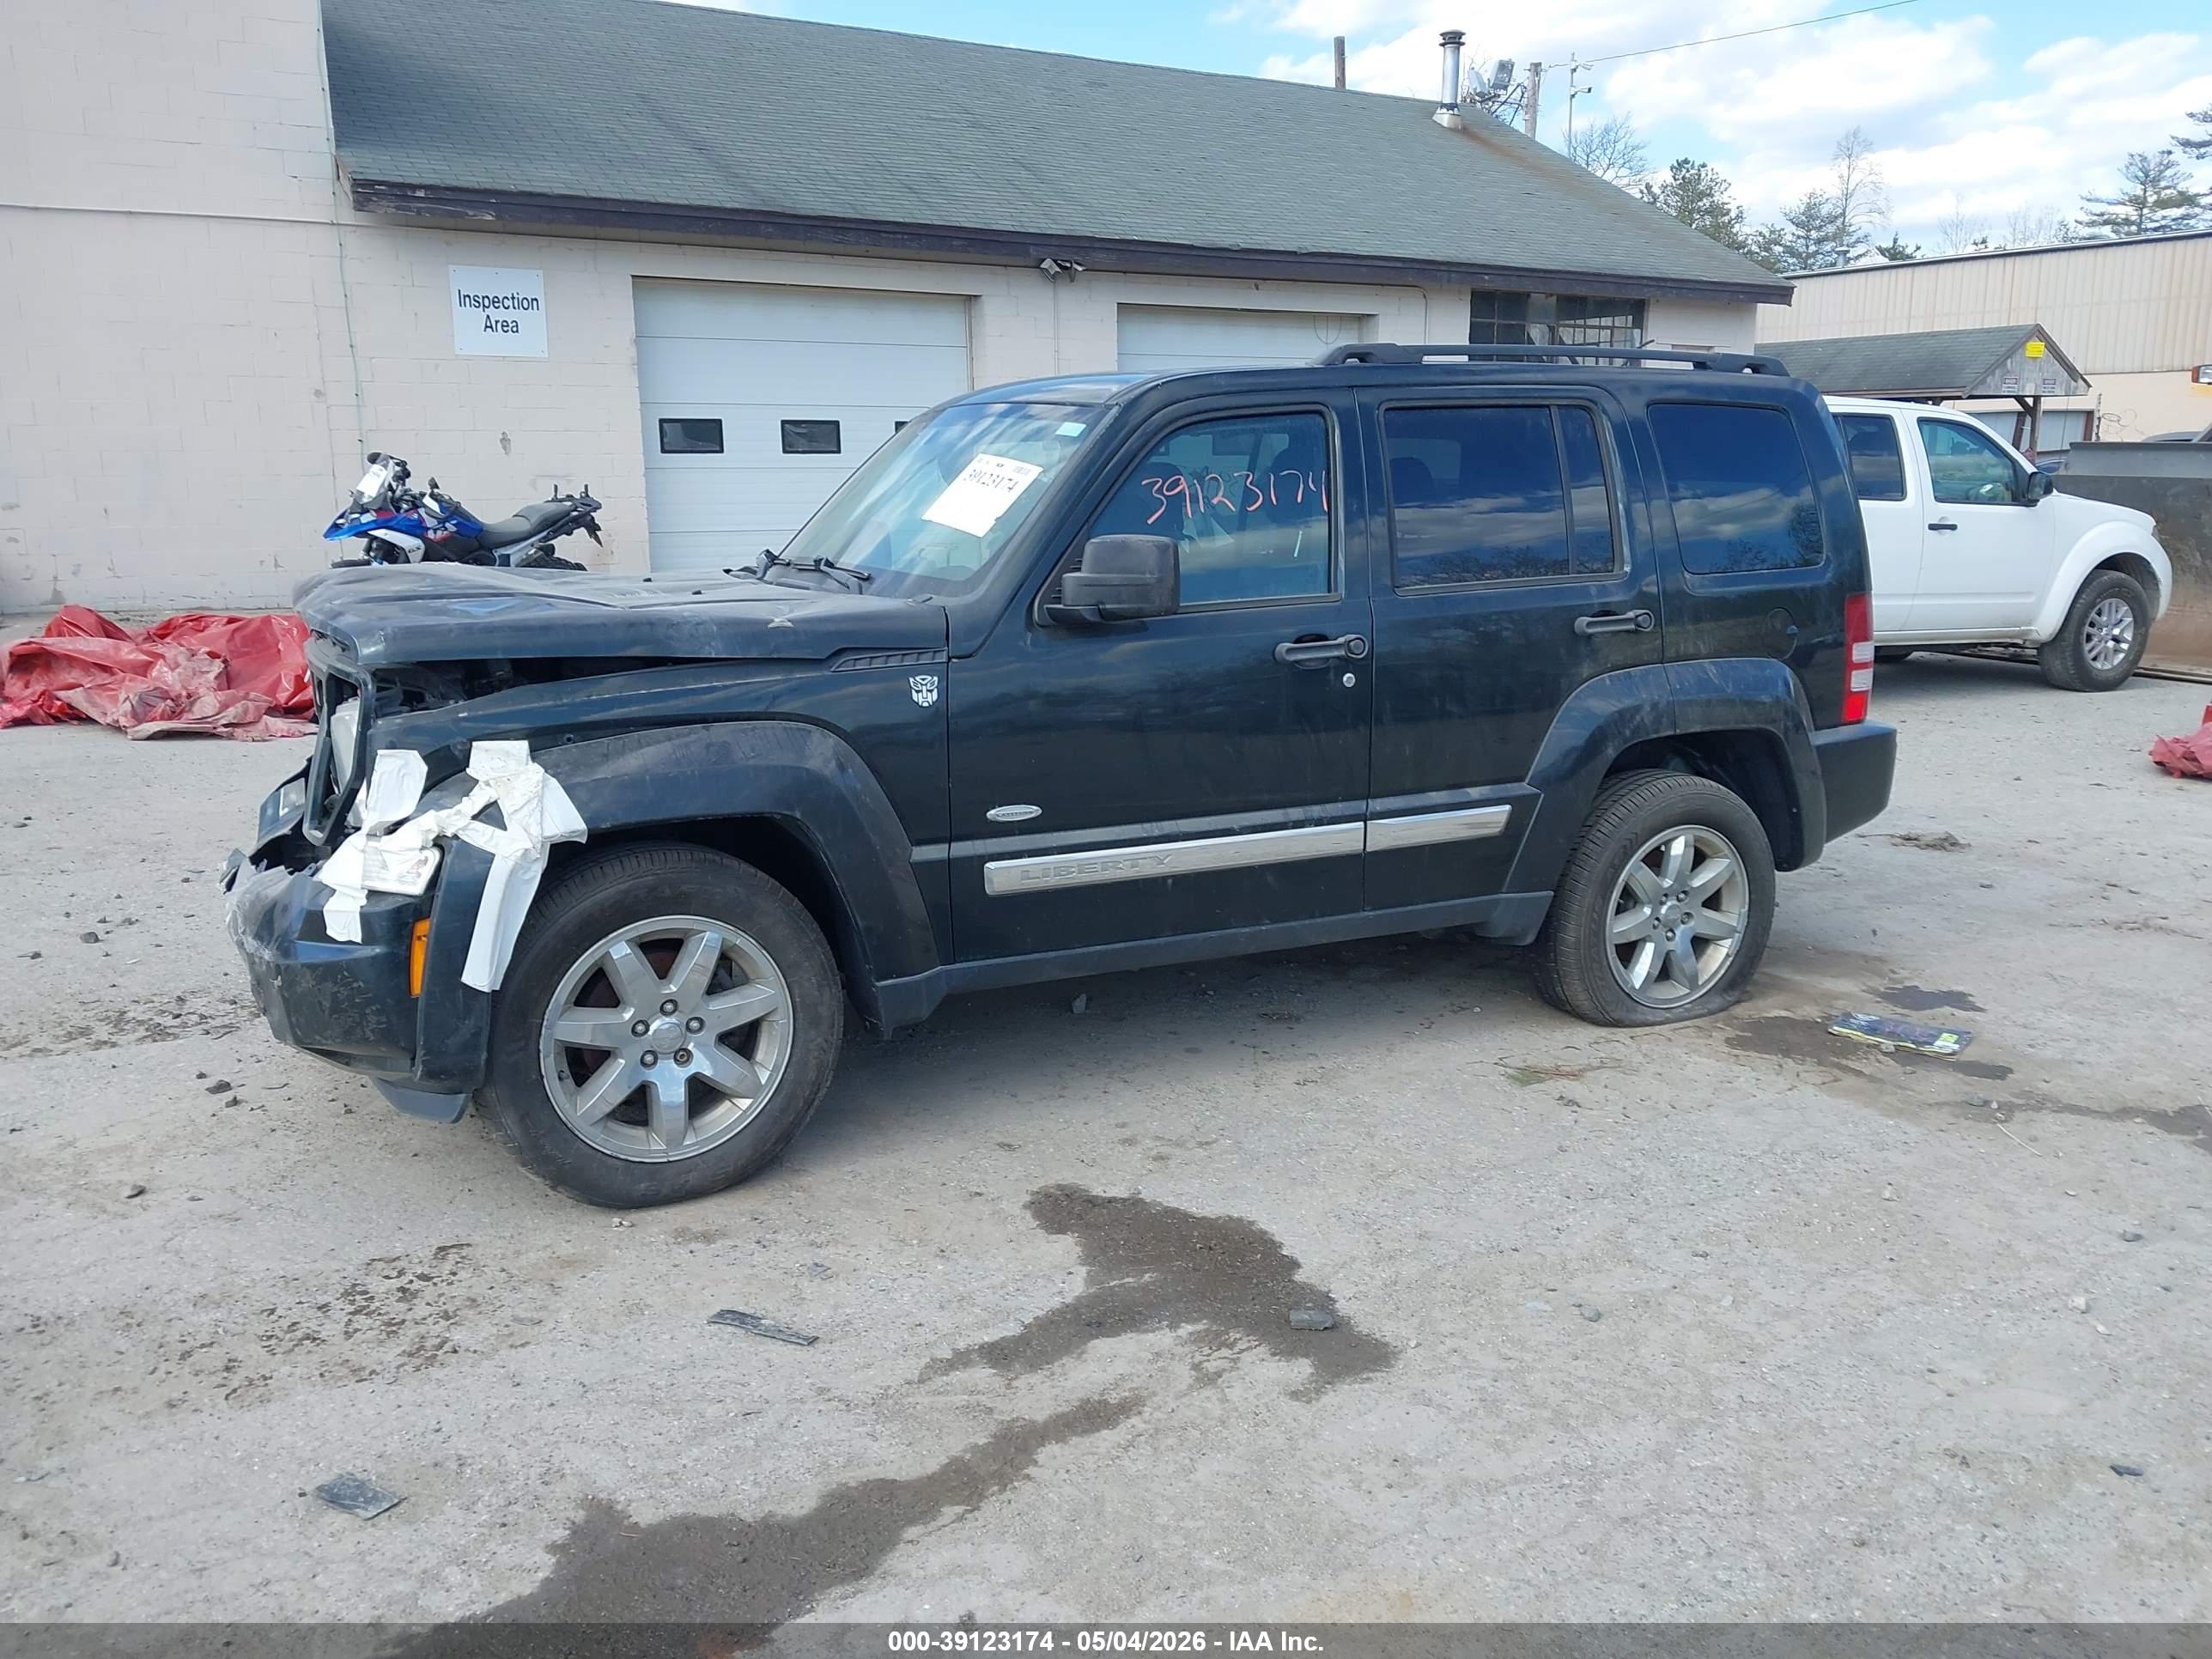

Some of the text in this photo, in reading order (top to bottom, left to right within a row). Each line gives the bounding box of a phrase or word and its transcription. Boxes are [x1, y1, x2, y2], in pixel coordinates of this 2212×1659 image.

[458, 289, 539, 313] Inspection
[483, 314, 520, 333] Area
[1020, 854, 1172, 884] LIBERTY
